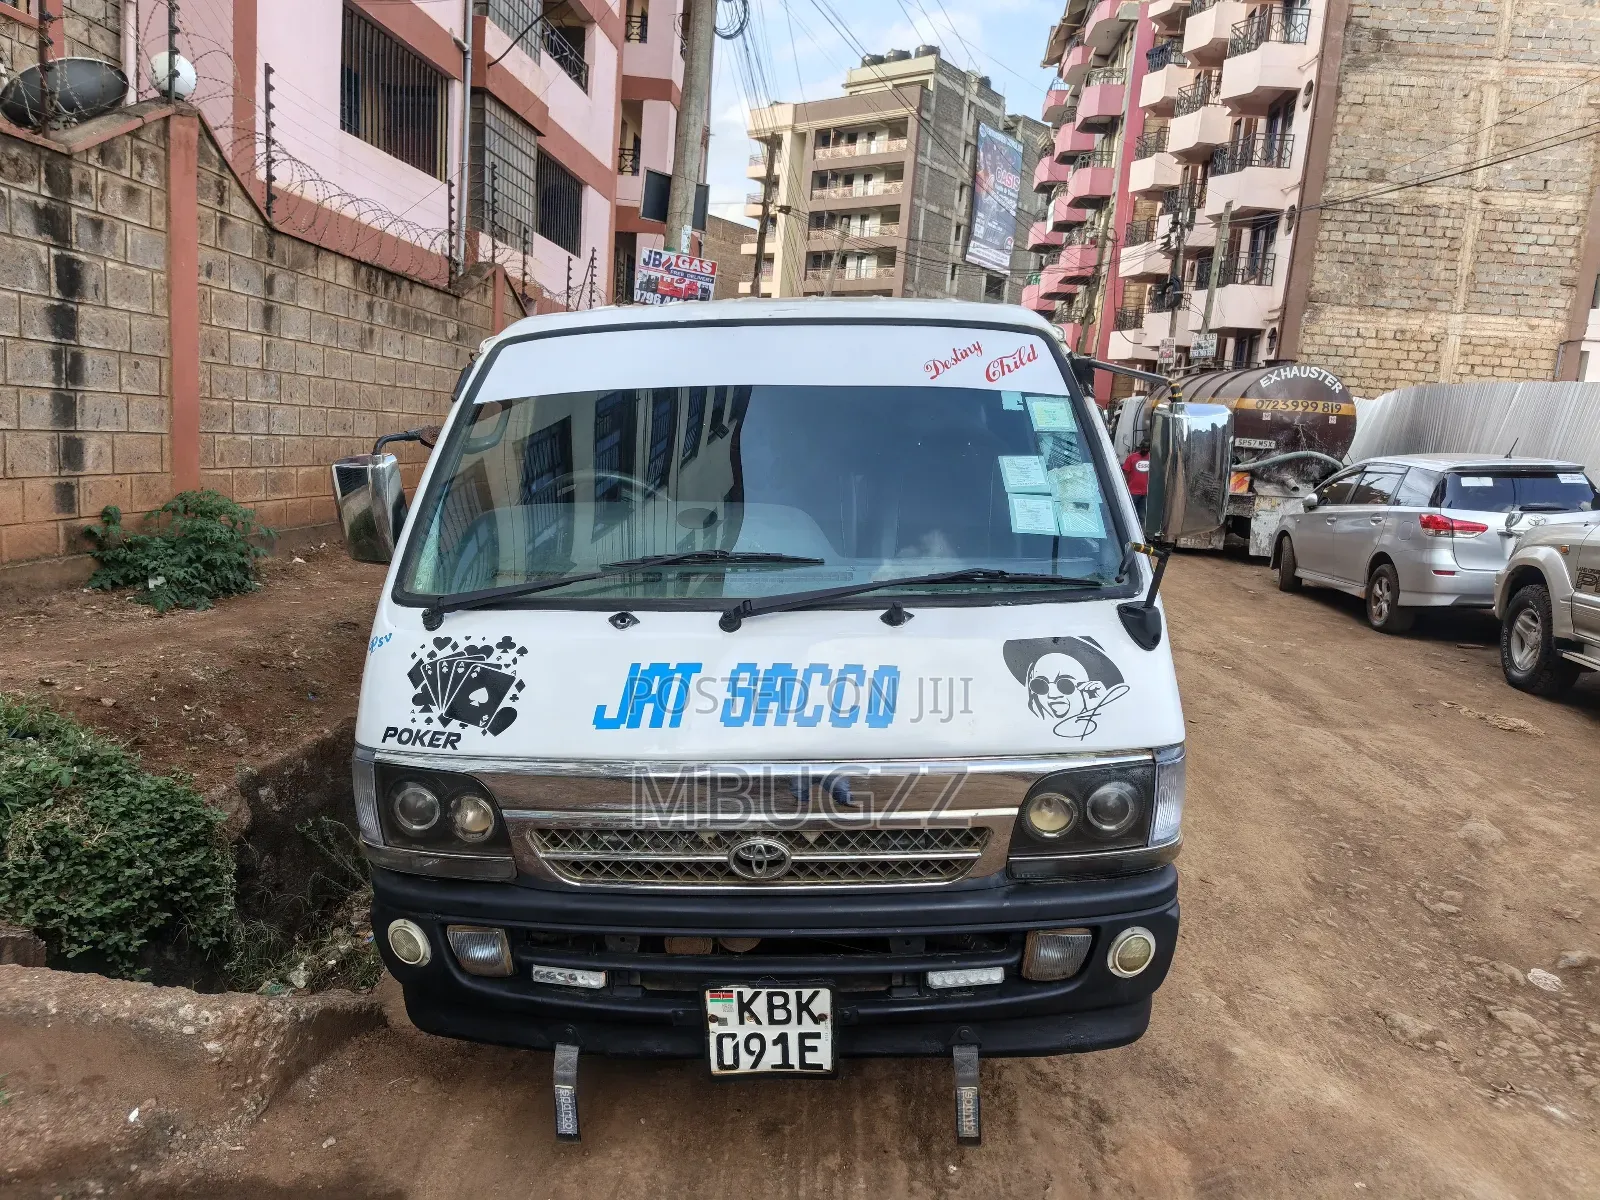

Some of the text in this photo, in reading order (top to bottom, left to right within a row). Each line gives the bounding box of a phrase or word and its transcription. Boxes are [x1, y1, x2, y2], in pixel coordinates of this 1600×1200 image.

[642, 249, 713, 274] JB GAS
[924, 341, 1038, 383] Destiny Child
[1260, 366, 1343, 394] EXHAUSTER
[719, 662, 900, 729] SACCO
[381, 726, 462, 751] POKER
[736, 989, 821, 1026] KBK
[715, 1031, 824, 1071] 091E
